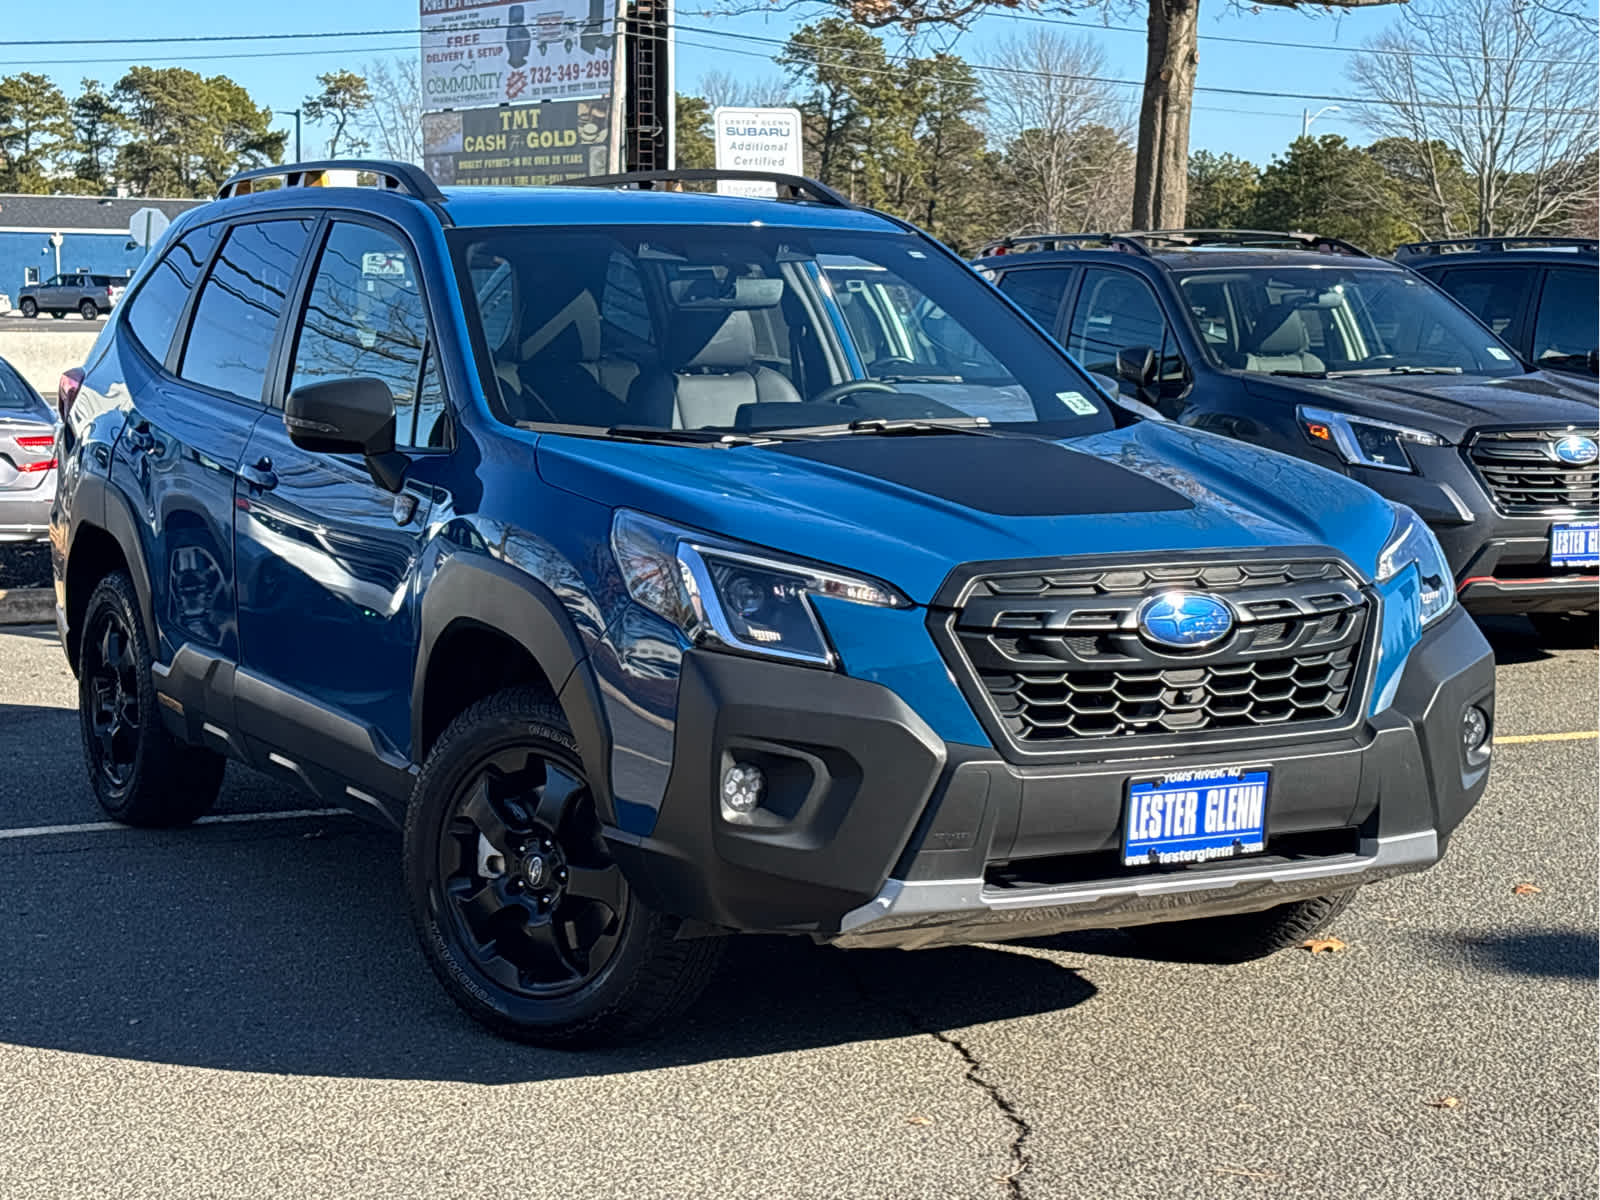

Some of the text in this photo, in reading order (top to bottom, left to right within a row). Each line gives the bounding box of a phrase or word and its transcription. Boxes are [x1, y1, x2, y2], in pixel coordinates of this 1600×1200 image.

[447, 33, 480, 48] FREE
[426, 46, 504, 63] DELIVERY & SETUP
[427, 72, 503, 95] COMMUNITY
[500, 108, 541, 131] TMT
[464, 134, 507, 152] CASH
[527, 130, 577, 148] GOLD
[726, 127, 790, 137] SUBARU
[729, 141, 788, 152] Additional
[733, 156, 785, 167] Certified
[1552, 531, 1585, 554] LESTER
[1129, 785, 1265, 840] LESTER GLENN
